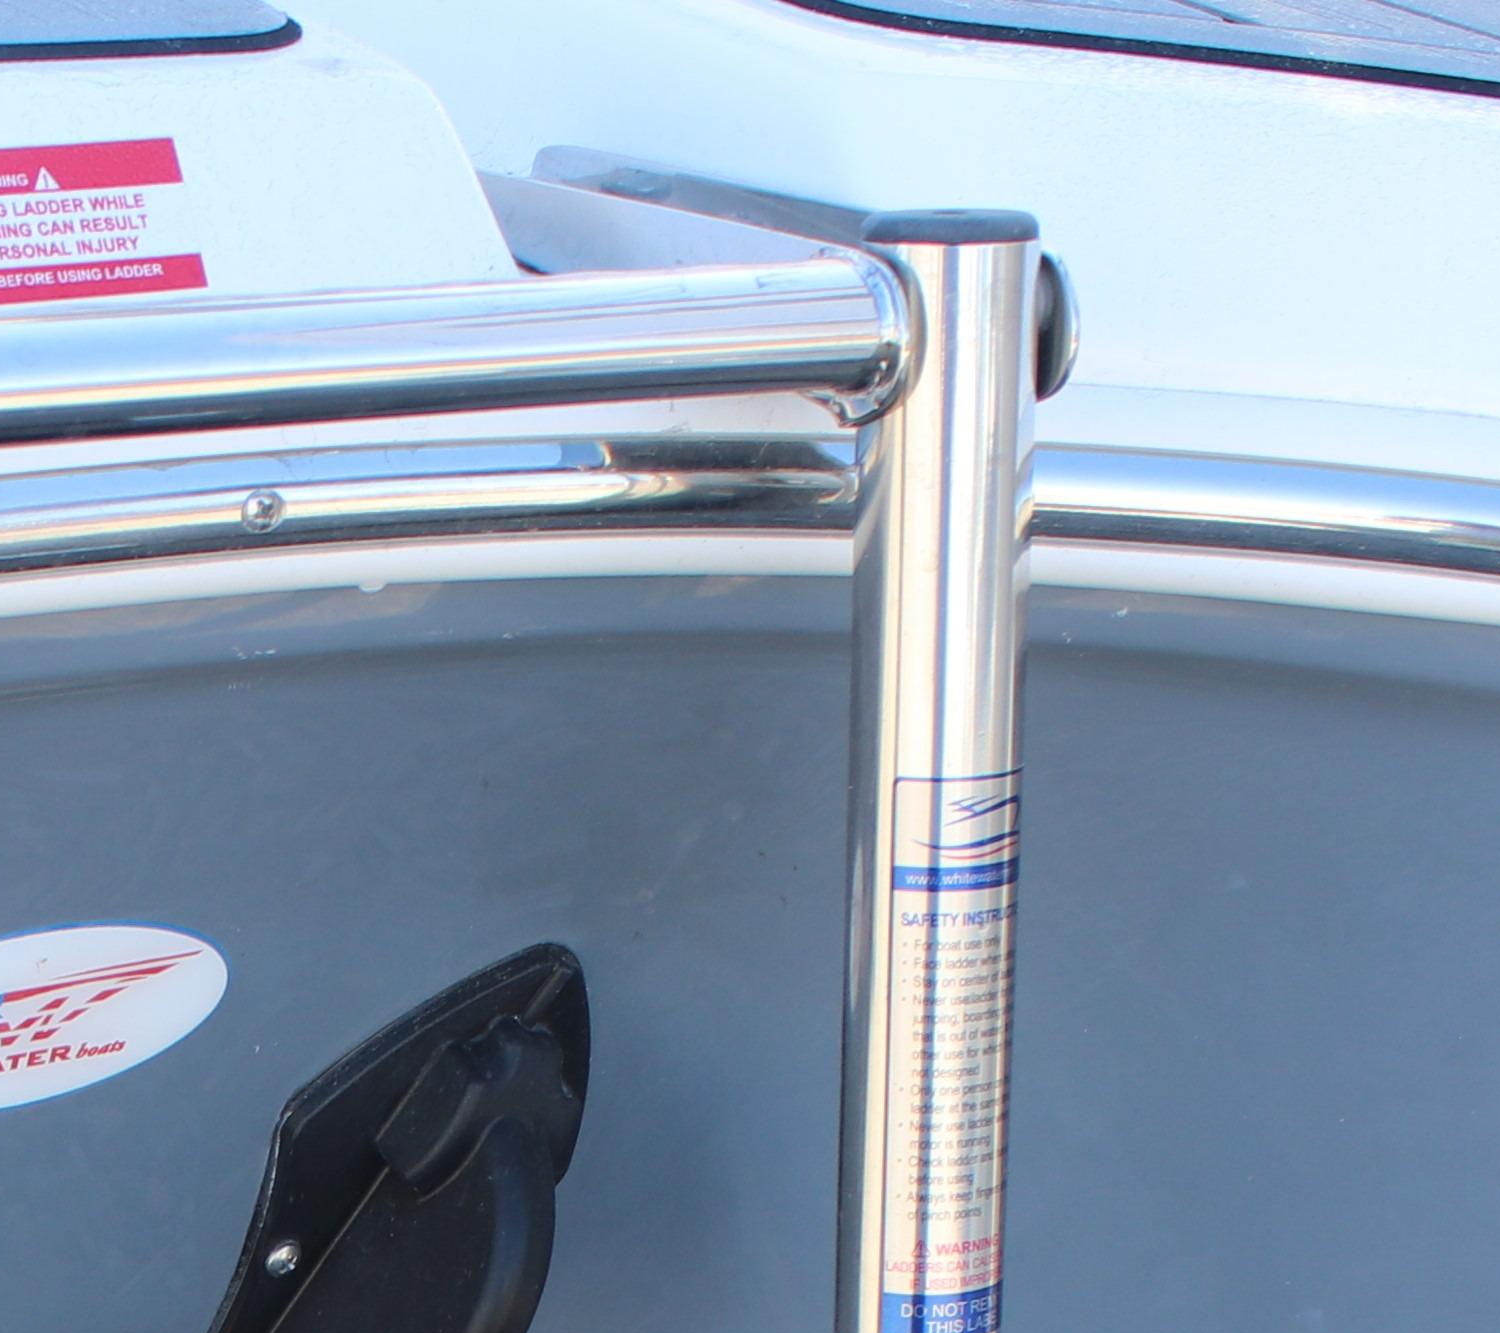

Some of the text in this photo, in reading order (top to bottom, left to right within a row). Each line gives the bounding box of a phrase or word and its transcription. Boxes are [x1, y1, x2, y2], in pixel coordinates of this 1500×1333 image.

[12, 198, 85, 217] LADDER
[87, 193, 145, 212] WHILE
[37, 218, 74, 236] CAN
[80, 214, 148, 233] RESULT
[76, 236, 140, 256] INJURY
[57, 268, 102, 284] USING
[105, 264, 164, 280] LADDER
[901, 904, 1017, 928] SAFETY INSTRU
[75, 1039, 127, 1060] boats
[936, 1232, 1000, 1256] WARNING
[900, 1303, 928, 1319] DO
[932, 1300, 968, 1319] NOT
[966, 1308, 1001, 1333] LABE
